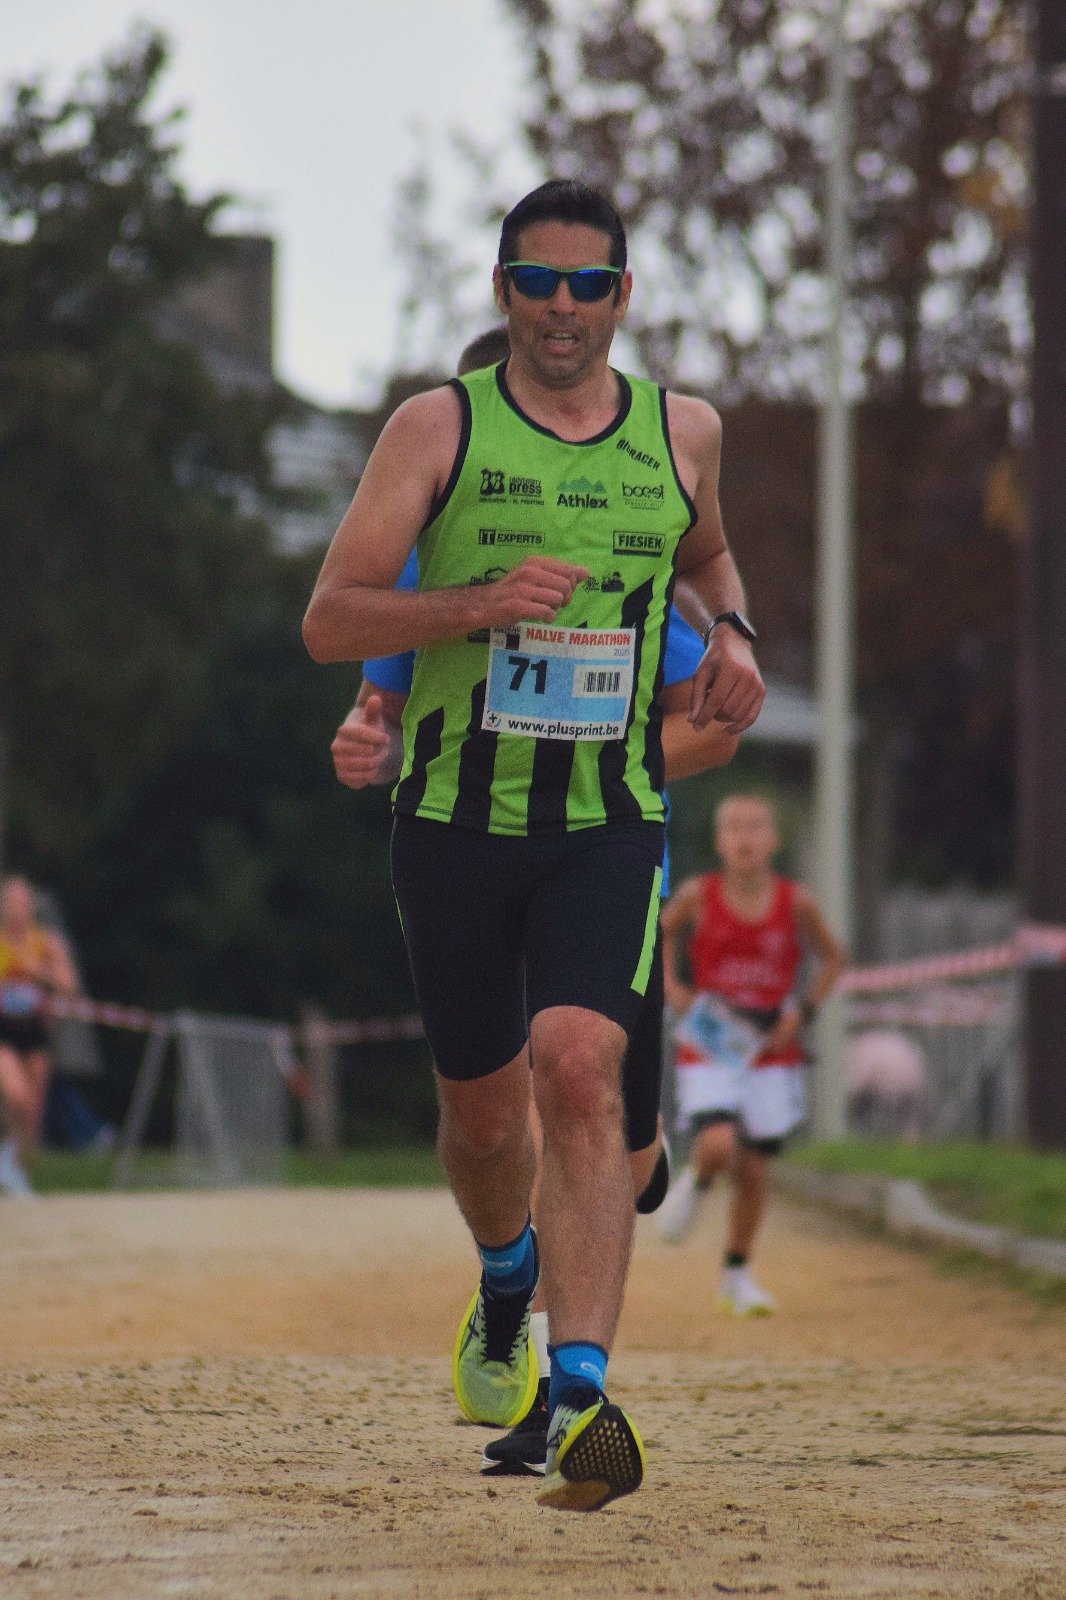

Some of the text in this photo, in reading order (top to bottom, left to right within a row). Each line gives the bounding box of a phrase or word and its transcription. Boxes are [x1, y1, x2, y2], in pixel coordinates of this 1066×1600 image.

[509, 482, 542, 495] press
[556, 493, 609, 509] Athlex
[497, 533, 542, 544] EXPERTS
[618, 534, 663, 549] FIESIEK
[526, 627, 565, 644] HALVE
[568, 632, 631, 646] MARATHON
[508, 655, 548, 695] 71
[508, 719, 619, 739] www.plusprint.be
